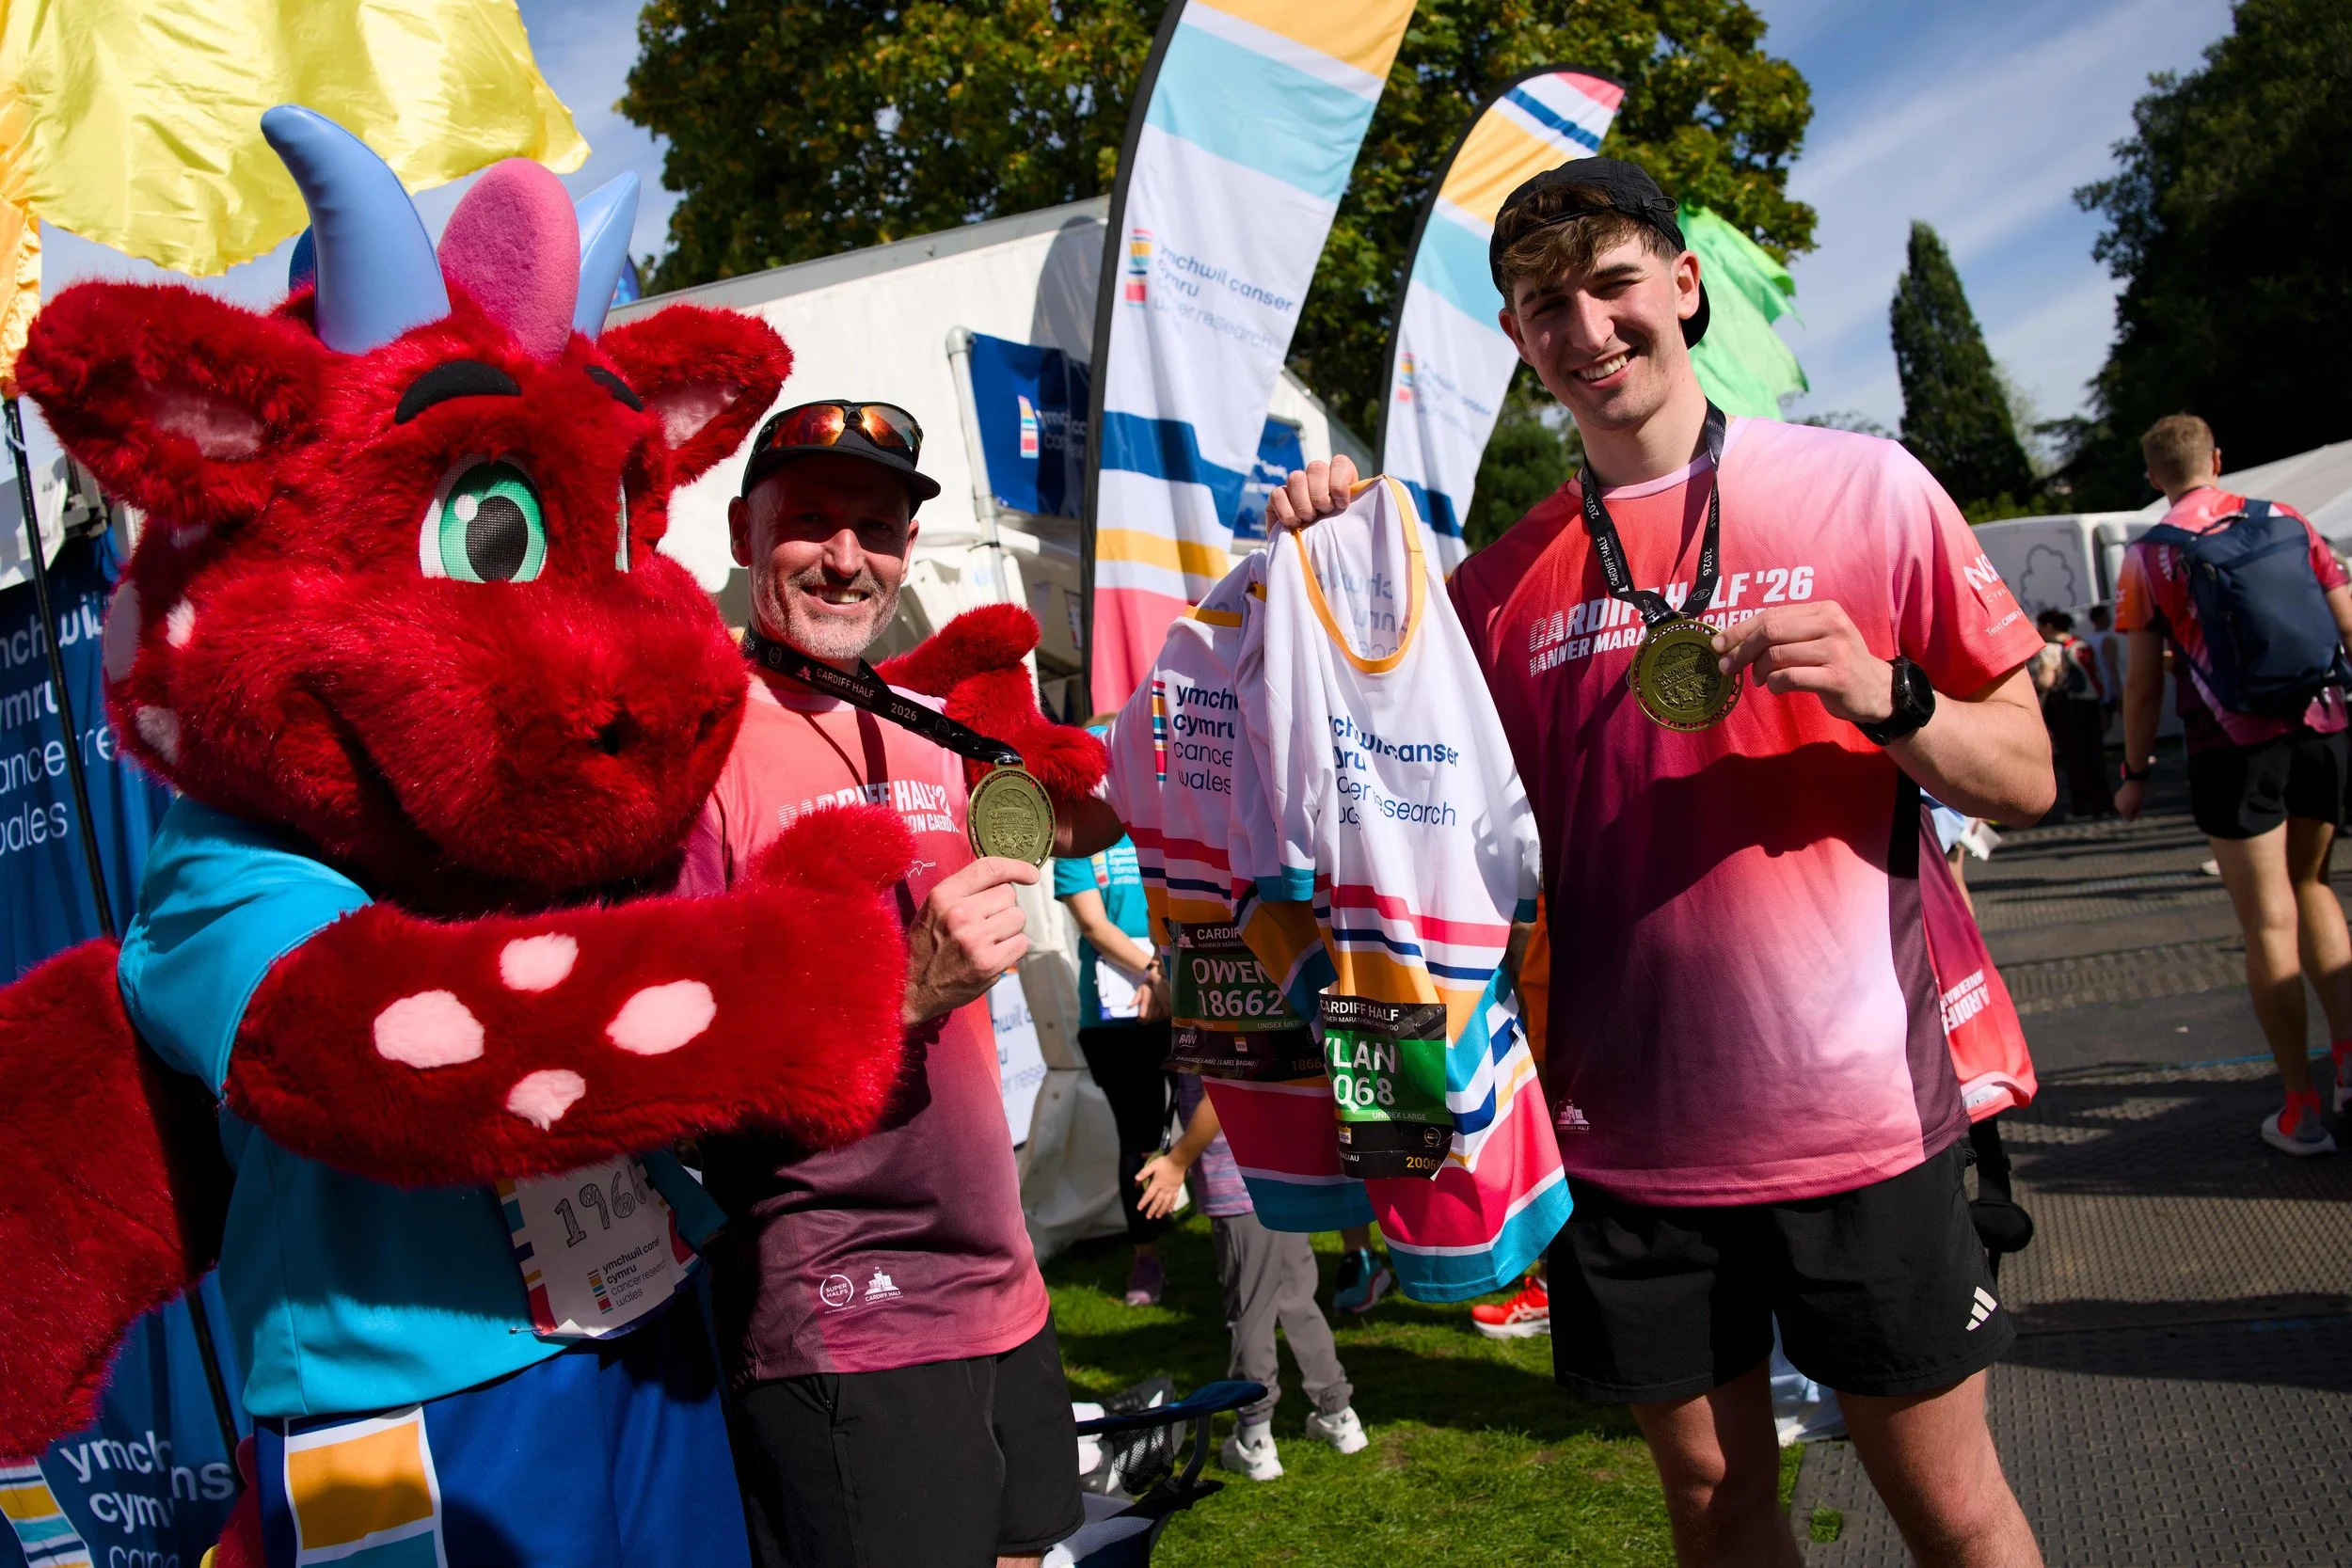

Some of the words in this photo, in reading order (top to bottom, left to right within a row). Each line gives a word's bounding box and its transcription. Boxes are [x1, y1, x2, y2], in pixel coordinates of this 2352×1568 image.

[1229, 278, 1295, 311] canser
[1597, 536, 1611, 557] HALF
[1602, 556, 1620, 587] CARDIFF
[1703, 547, 1712, 577] 2026
[1664, 572, 1750, 611] HLF
[816, 668, 851, 689] CARDIFF
[851, 682, 875, 699] HALF
[890, 703, 917, 721] 2026
[1198, 989, 1284, 1017] 18662
[1320, 999, 1366, 1015] CARDIFF
[1368, 1005, 1399, 1022] HALF
[1257, 1021, 1282, 1029] UNISEX
[1372, 1111, 1401, 1119] UNISEX
[1403, 1112, 1426, 1120] LARGE
[602, 1245, 643, 1275] ymchwil
[607, 1264, 637, 1285] cymru
[611, 1275, 643, 1296] cancer
[825, 1283, 848, 1293] SUPER
[826, 1289, 849, 1298] HALFS
[616, 1288, 644, 1307] wales
[865, 1292, 888, 1302] CARDIFF
